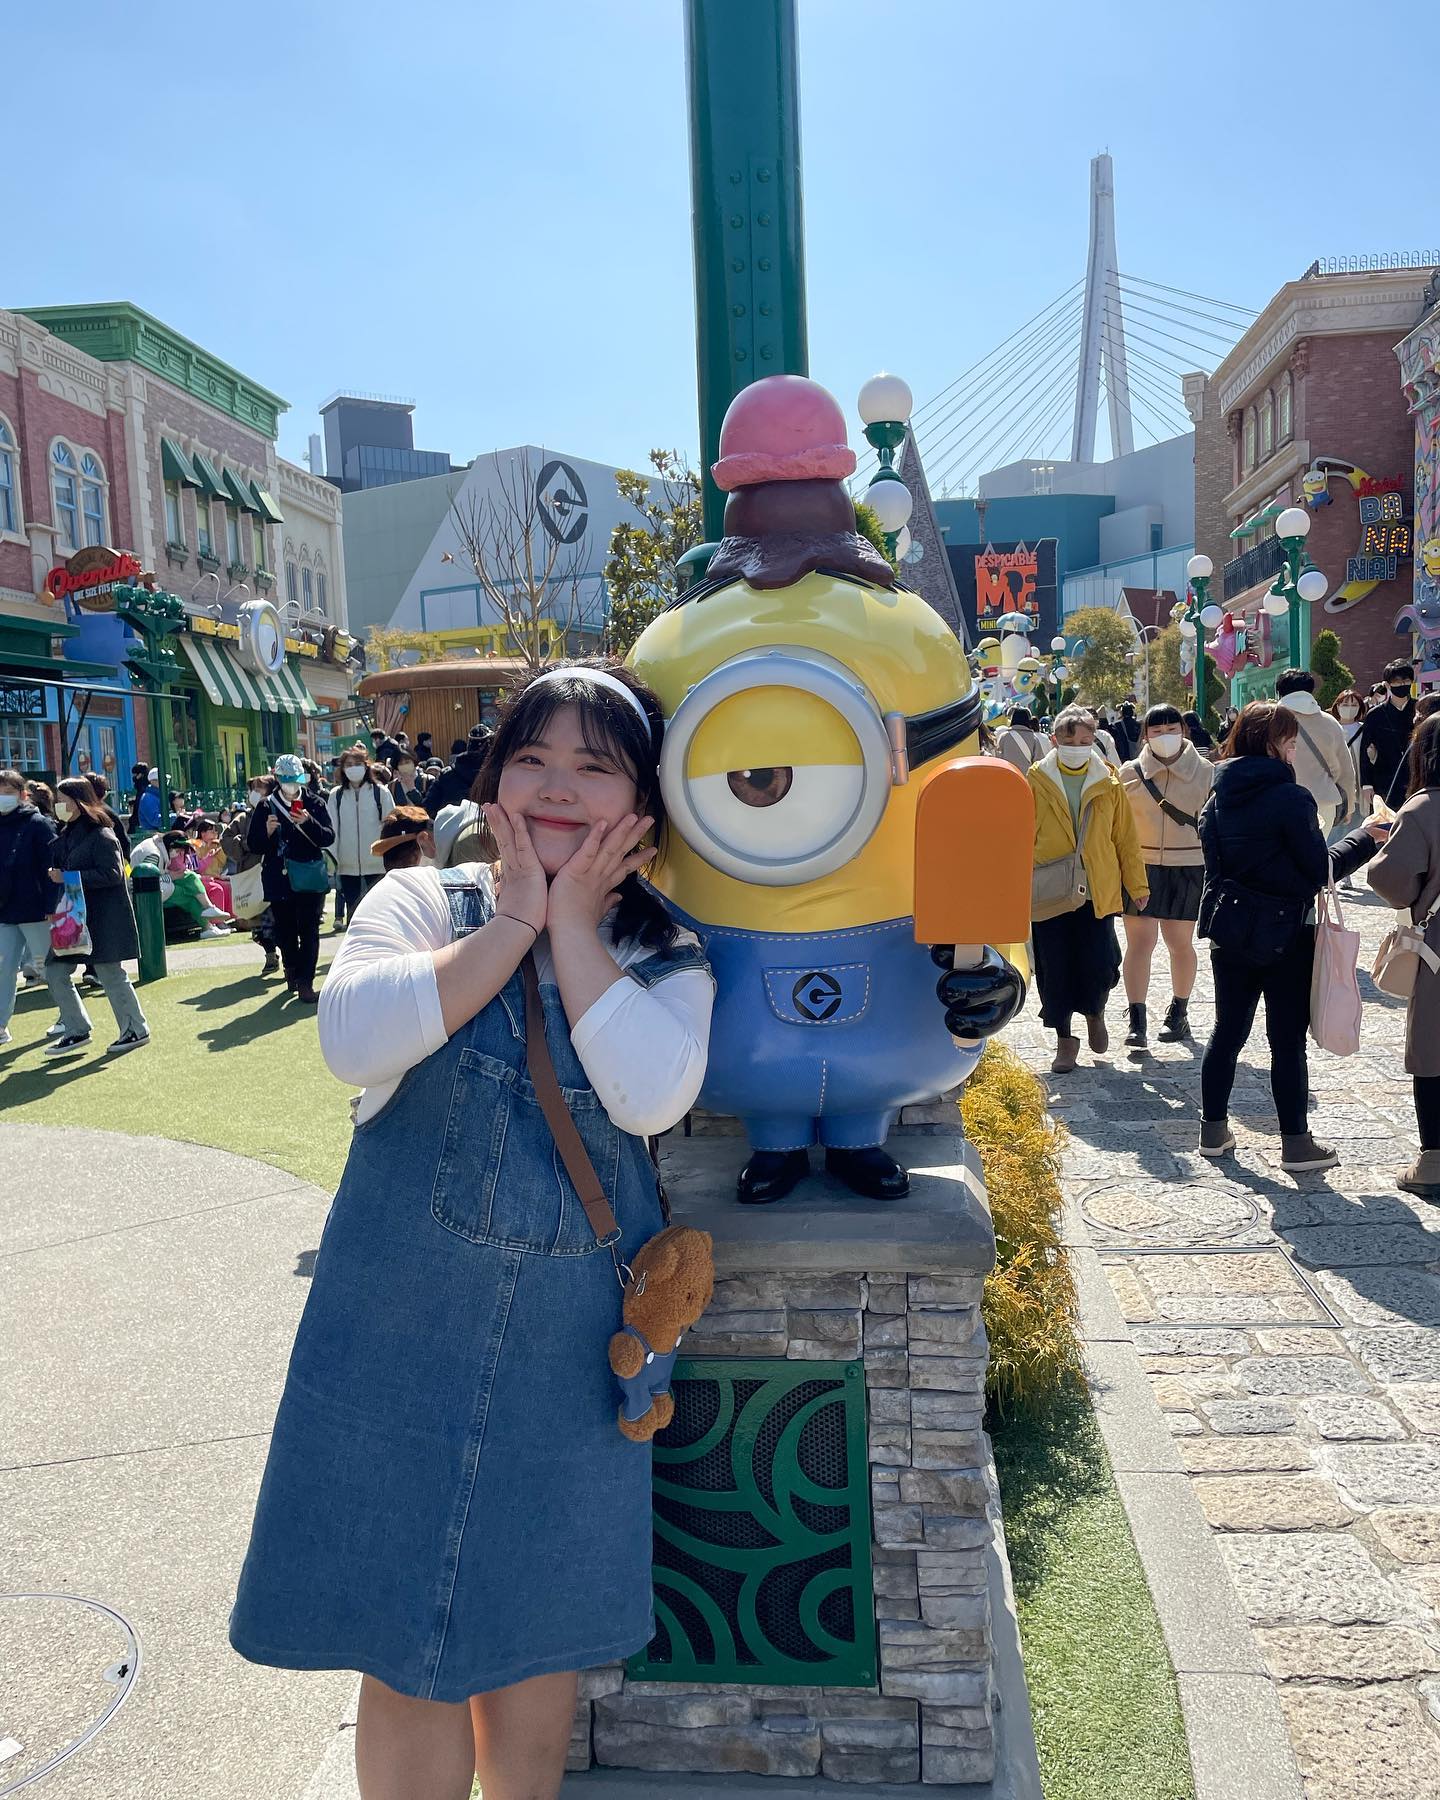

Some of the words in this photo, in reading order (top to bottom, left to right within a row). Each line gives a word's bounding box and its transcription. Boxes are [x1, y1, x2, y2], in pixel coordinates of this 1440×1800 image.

[1359, 493, 1403, 524] BA
[1363, 525, 1410, 556] NA
[975, 551, 1038, 569] DESPICABLE
[1346, 555, 1398, 582] NA!
[976, 564, 1039, 616] ME
